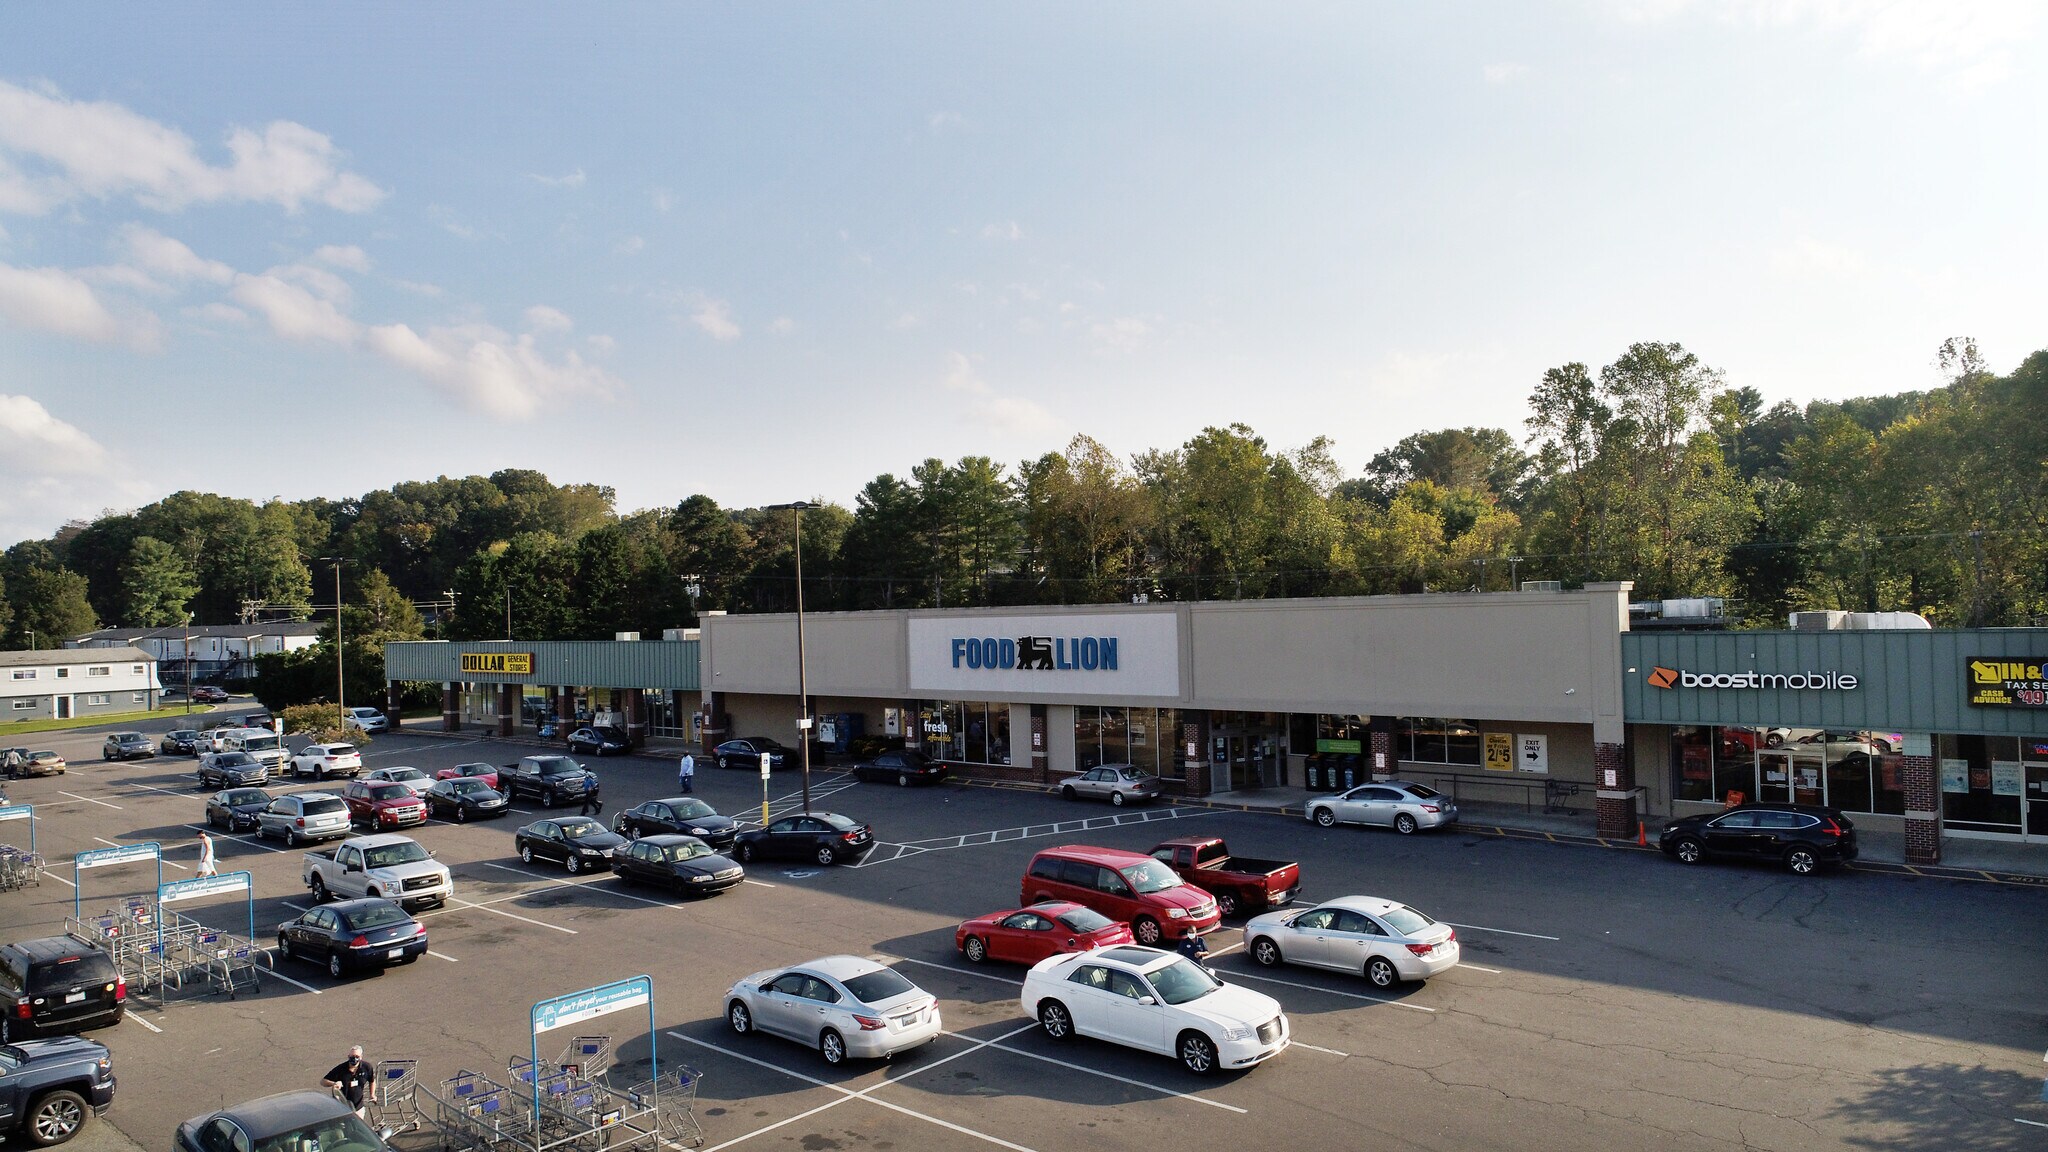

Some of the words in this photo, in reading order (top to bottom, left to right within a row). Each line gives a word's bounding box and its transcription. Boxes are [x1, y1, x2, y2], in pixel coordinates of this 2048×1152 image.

[952, 637, 1015, 669] FOOD
[1056, 636, 1118, 670] LION
[462, 655, 504, 670] DOLLAR
[508, 655, 528, 663] GENERAL
[2005, 681, 2028, 689] TAX
[1973, 696, 2012, 704] ADVANCE
[924, 720, 948, 733] fresh
